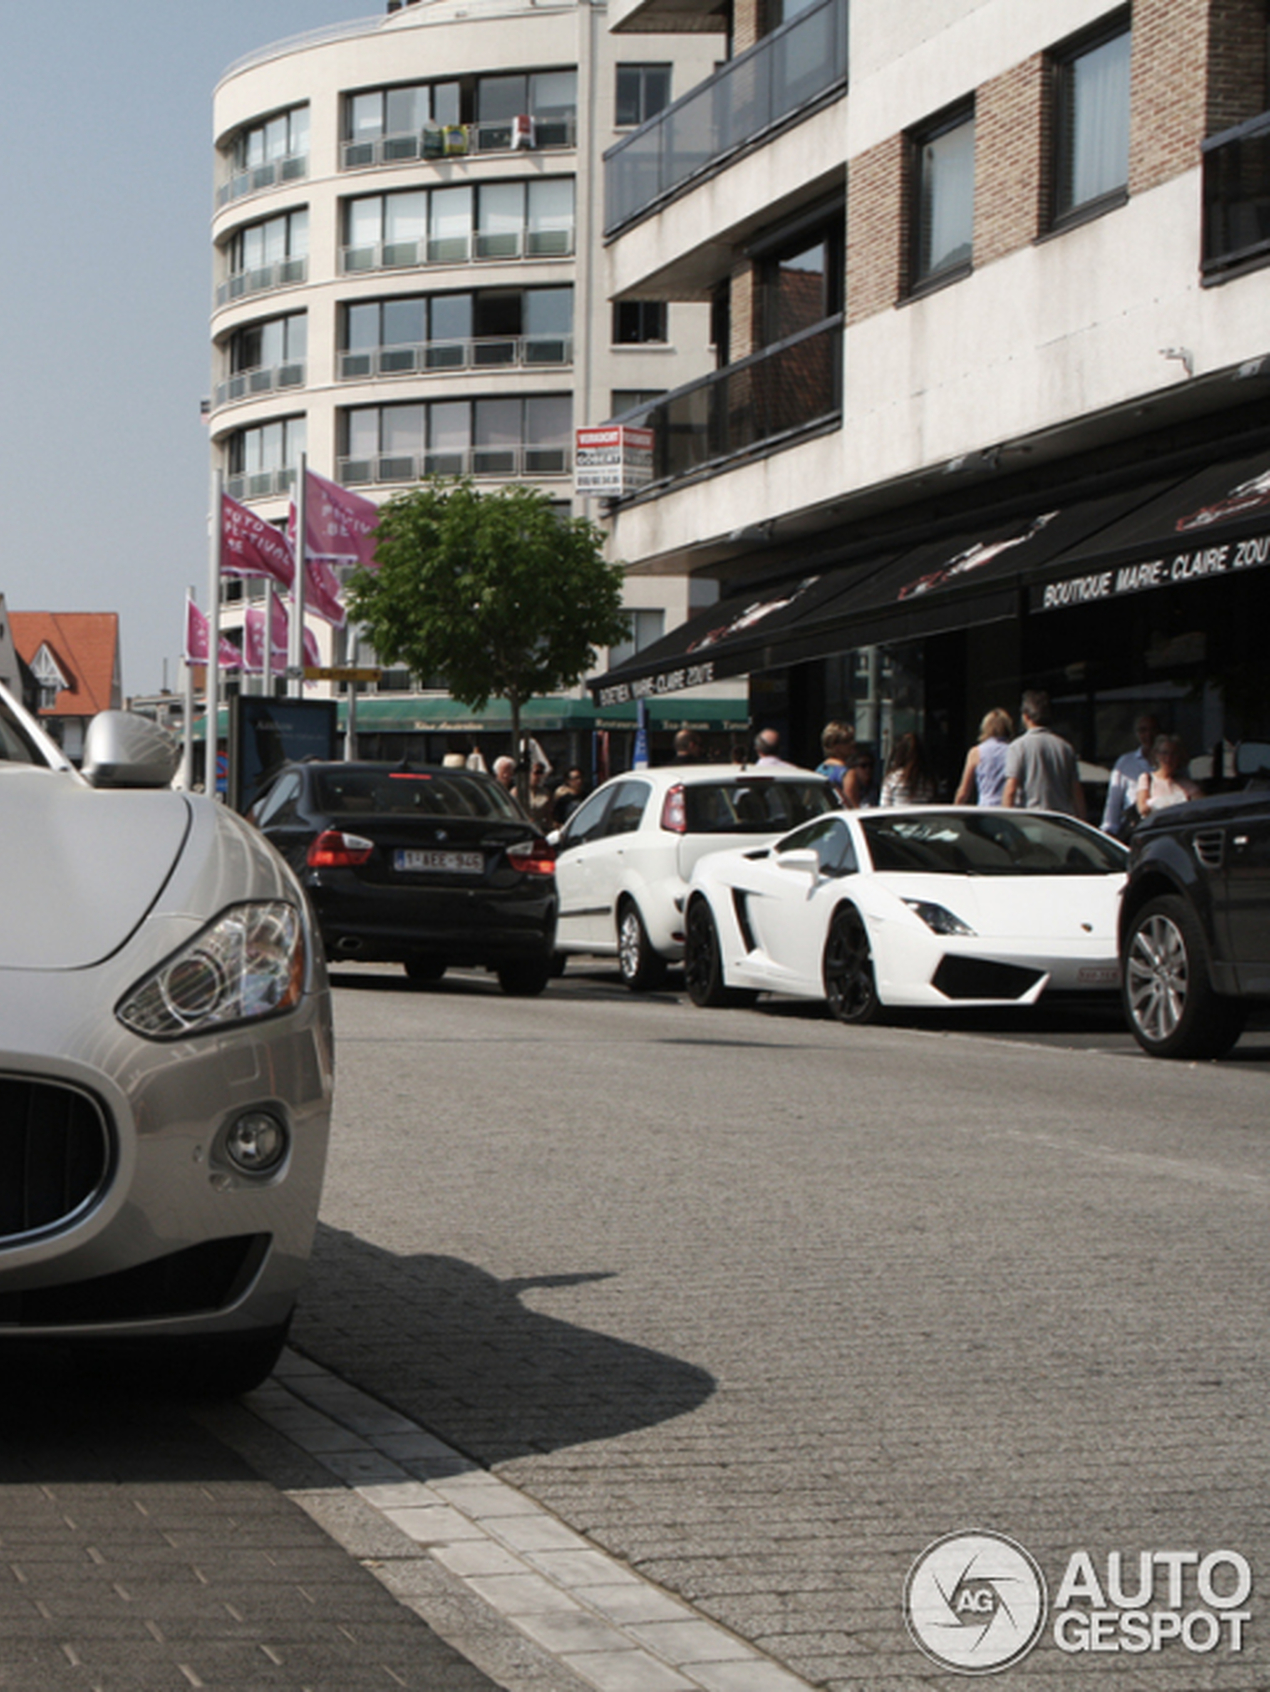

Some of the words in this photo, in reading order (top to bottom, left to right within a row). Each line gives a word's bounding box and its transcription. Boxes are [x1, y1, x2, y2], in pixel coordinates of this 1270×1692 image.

[1043, 571, 1113, 608] BOUTIQUE
[1115, 545, 1231, 593] MARIE-CLAIRE
[1232, 535, 1270, 568] ZOU
